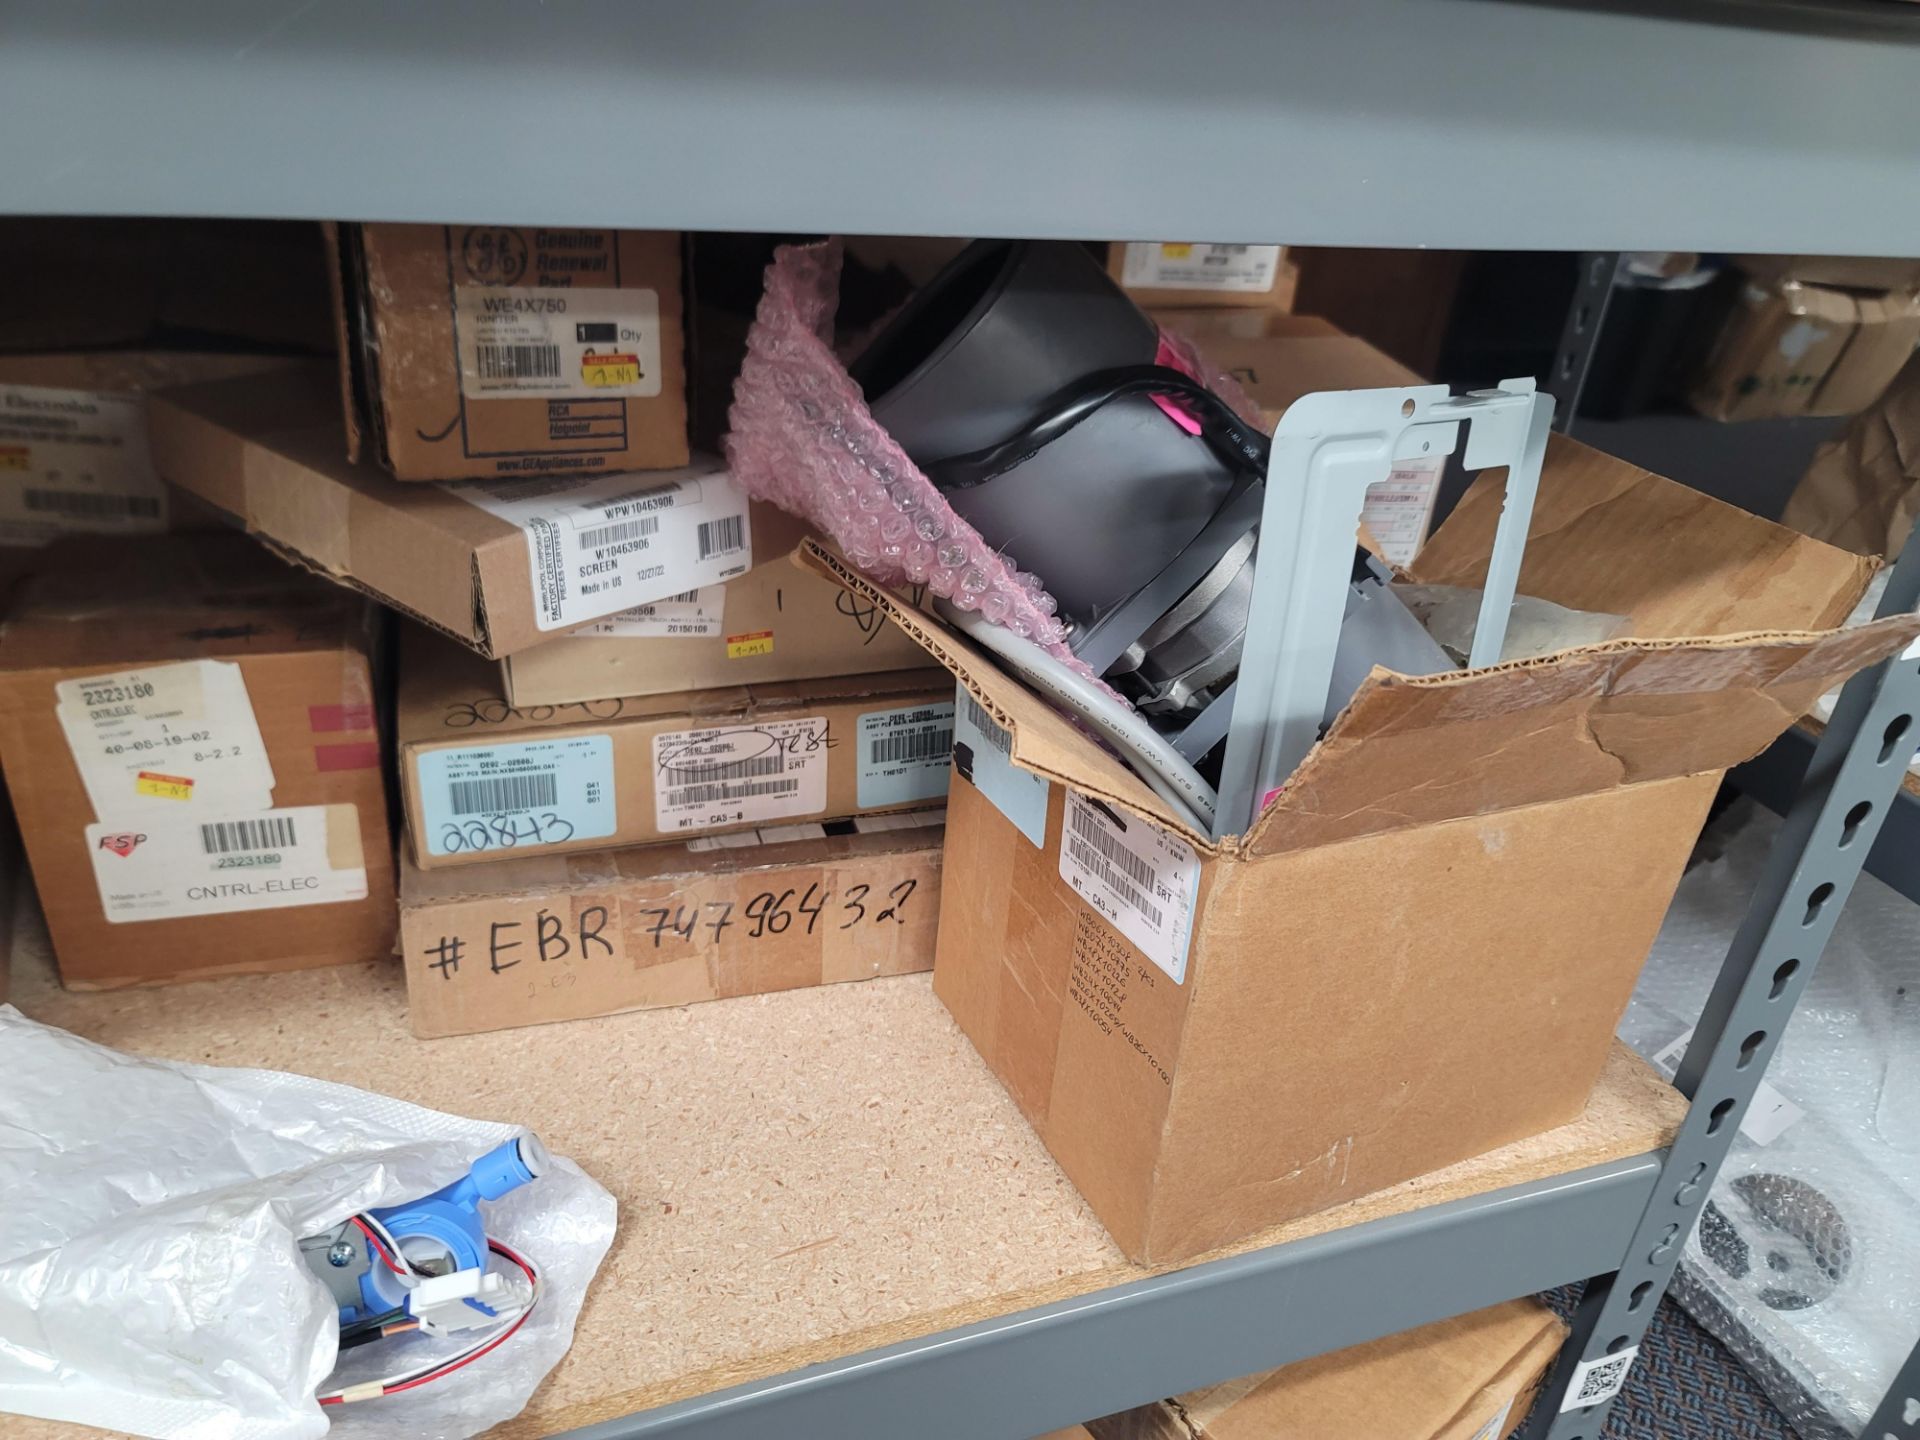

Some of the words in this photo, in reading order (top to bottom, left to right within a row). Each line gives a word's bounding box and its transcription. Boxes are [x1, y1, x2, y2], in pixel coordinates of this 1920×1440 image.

[535, 230, 605, 249] Genuine
[536, 254, 608, 273] Renewal
[483, 297, 567, 314] WE4X750
[578, 326, 587, 342] 1
[620, 329, 643, 342] Qty
[548, 404, 570, 417] RCA
[550, 422, 591, 434] Hotpoint
[496, 455, 606, 472] www.GEAppliances.com
[543, 535, 557, 584] CERTIFIED
[579, 558, 619, 578] SCREEN
[581, 582, 600, 596] Made
[602, 580, 611, 593] in
[612, 576, 623, 588] US
[548, 582, 561, 622] FACTORY
[83, 681, 155, 707] 2323180
[774, 719, 840, 757] Test
[788, 759, 806, 771] SRT
[679, 818, 694, 828] MT
[99, 832, 149, 851] FSP
[217, 853, 283, 869] 2323180
[187, 876, 320, 901] CNTRL-ELEC
[1072, 875, 1083, 891] MT
[1155, 885, 1173, 904] SRT
[424, 936, 467, 981] #
[489, 904, 615, 975] EBR
